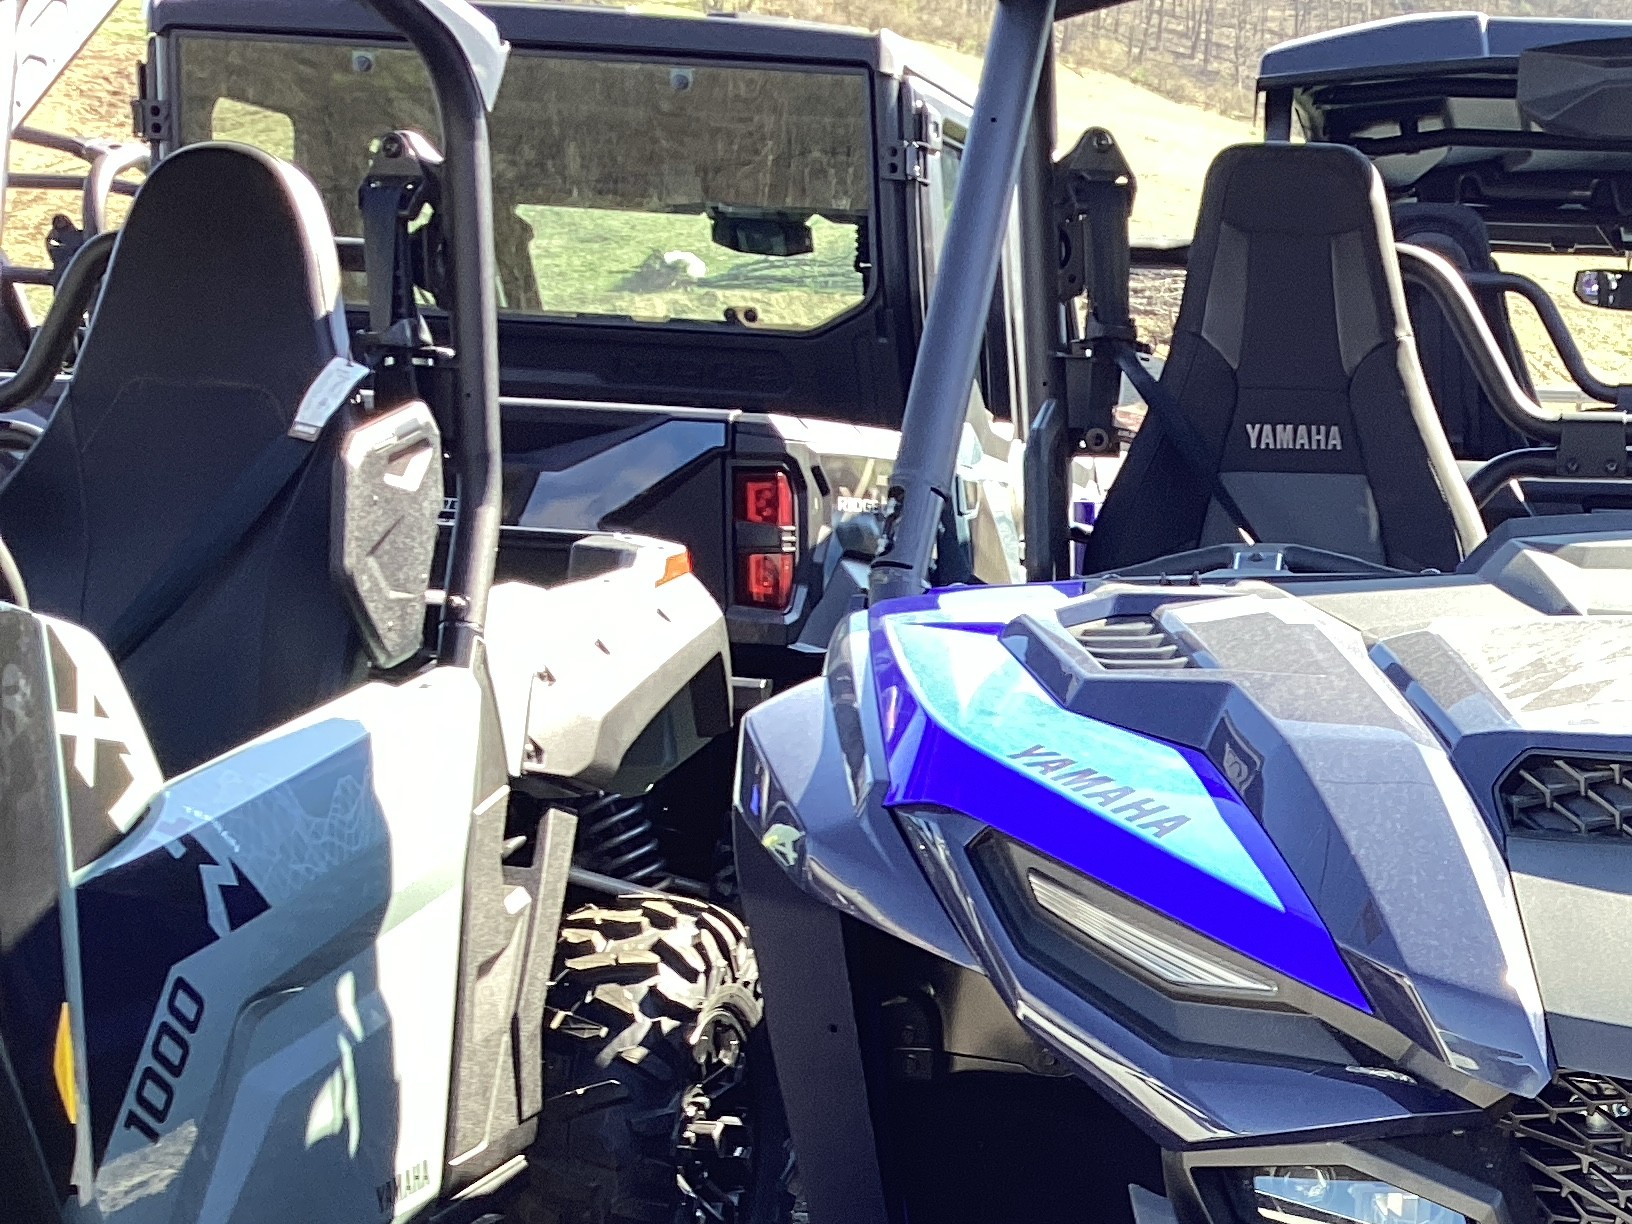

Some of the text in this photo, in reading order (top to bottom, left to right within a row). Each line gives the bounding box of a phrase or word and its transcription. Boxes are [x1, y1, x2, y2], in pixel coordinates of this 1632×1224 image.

[1245, 423, 1343, 451] YAMAHA
[1006, 744, 1191, 839] YAMAHA
[123, 975, 205, 1145] 1000
